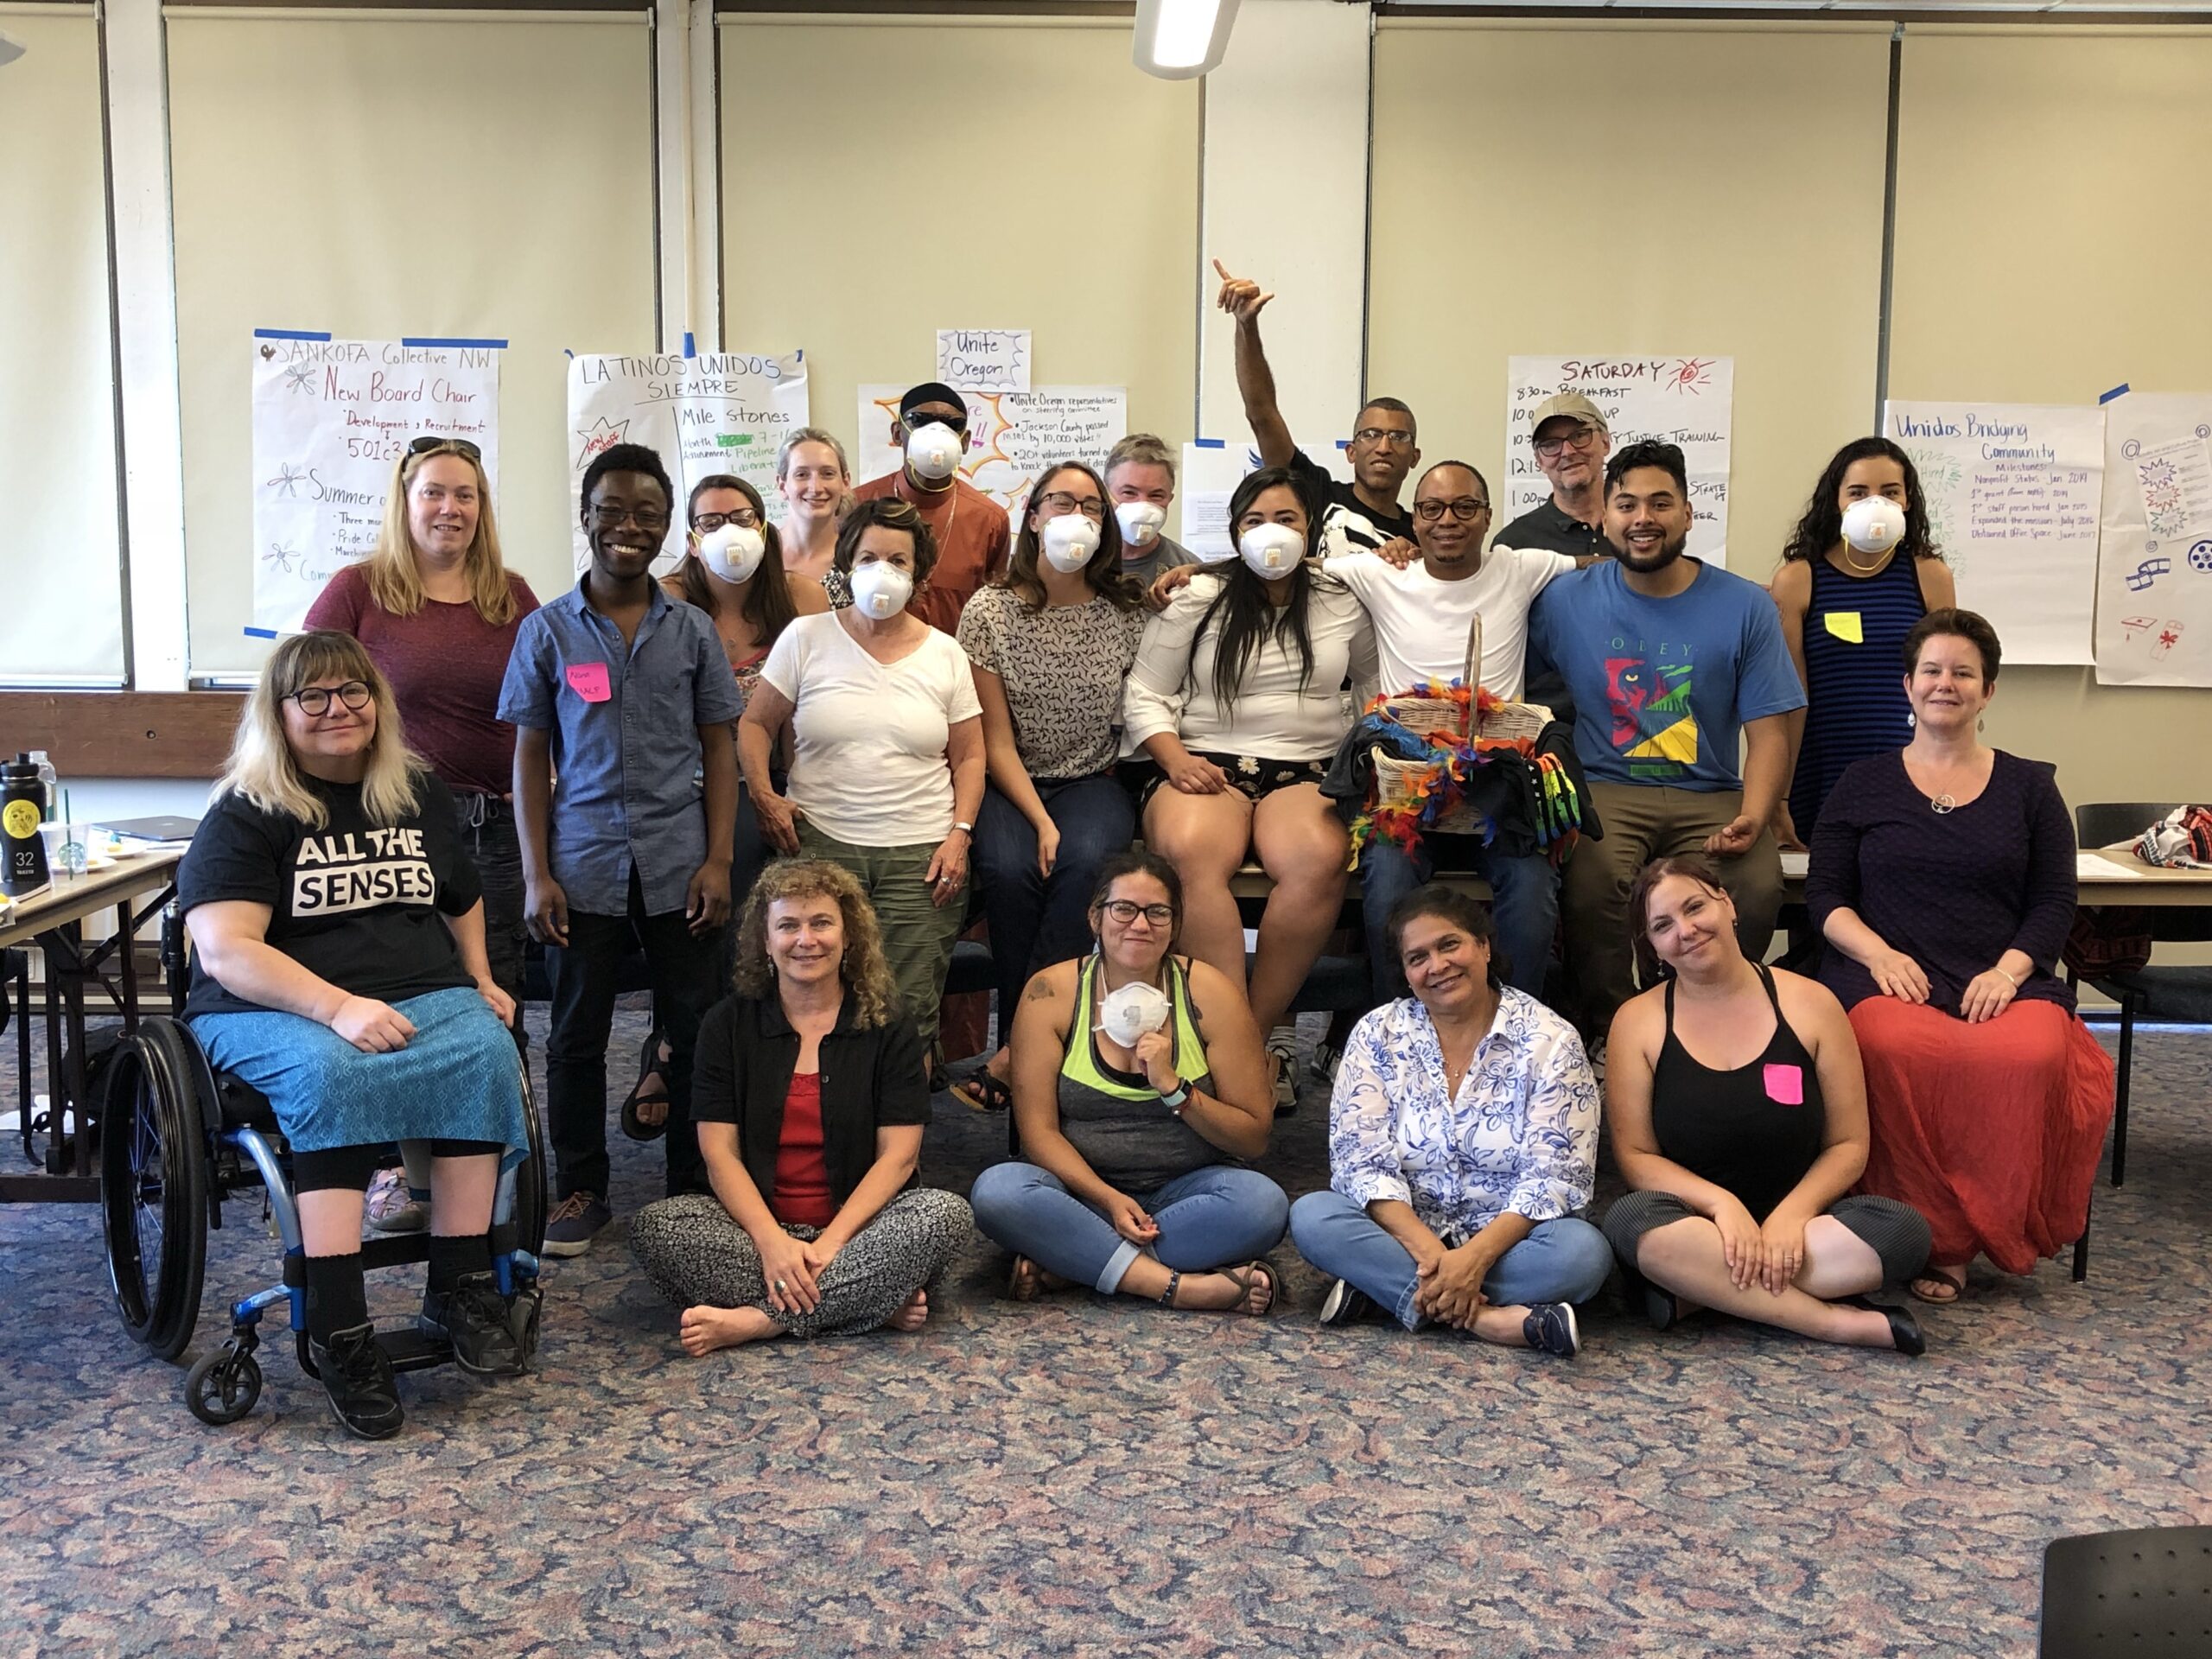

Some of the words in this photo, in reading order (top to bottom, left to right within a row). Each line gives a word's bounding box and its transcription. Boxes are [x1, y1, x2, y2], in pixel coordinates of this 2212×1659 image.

[957, 332, 1000, 353] Unite
[276, 340, 370, 364] SANKOFA
[382, 343, 448, 365] Collective
[459, 348, 492, 369] NW
[582, 355, 688, 384] LATINOS
[699, 355, 781, 378] UNIDOS
[950, 357, 1003, 384] Oregon
[1561, 361, 1666, 382] SATURDAY
[324, 365, 360, 402] New
[371, 371, 423, 404] Board
[432, 378, 477, 403] Chair
[647, 379, 739, 399] SIEMPRE
[1014, 394, 1037, 405] Unite
[346, 410, 409, 431] Development
[425, 418, 486, 433] Recruitment
[683, 409, 715, 426] Mile
[1021, 420, 1058, 432] Jackson
[1896, 415, 1962, 438] Unidos
[1030, 433, 1039, 448] by
[1044, 434, 1071, 444] 10,000
[1669, 429, 1726, 443] TRAINING
[735, 448, 776, 460] Pipeline
[1982, 442, 2055, 463] Community
[309, 468, 375, 505] Summer
[338, 512, 363, 525] Three
[338, 529, 361, 543] Pride
[1611, 637, 1692, 656] OBEY
[296, 833, 367, 865] ALL
[365, 827, 427, 857] THE
[16, 852, 34, 867] 32
[297, 867, 433, 909] SENSES
